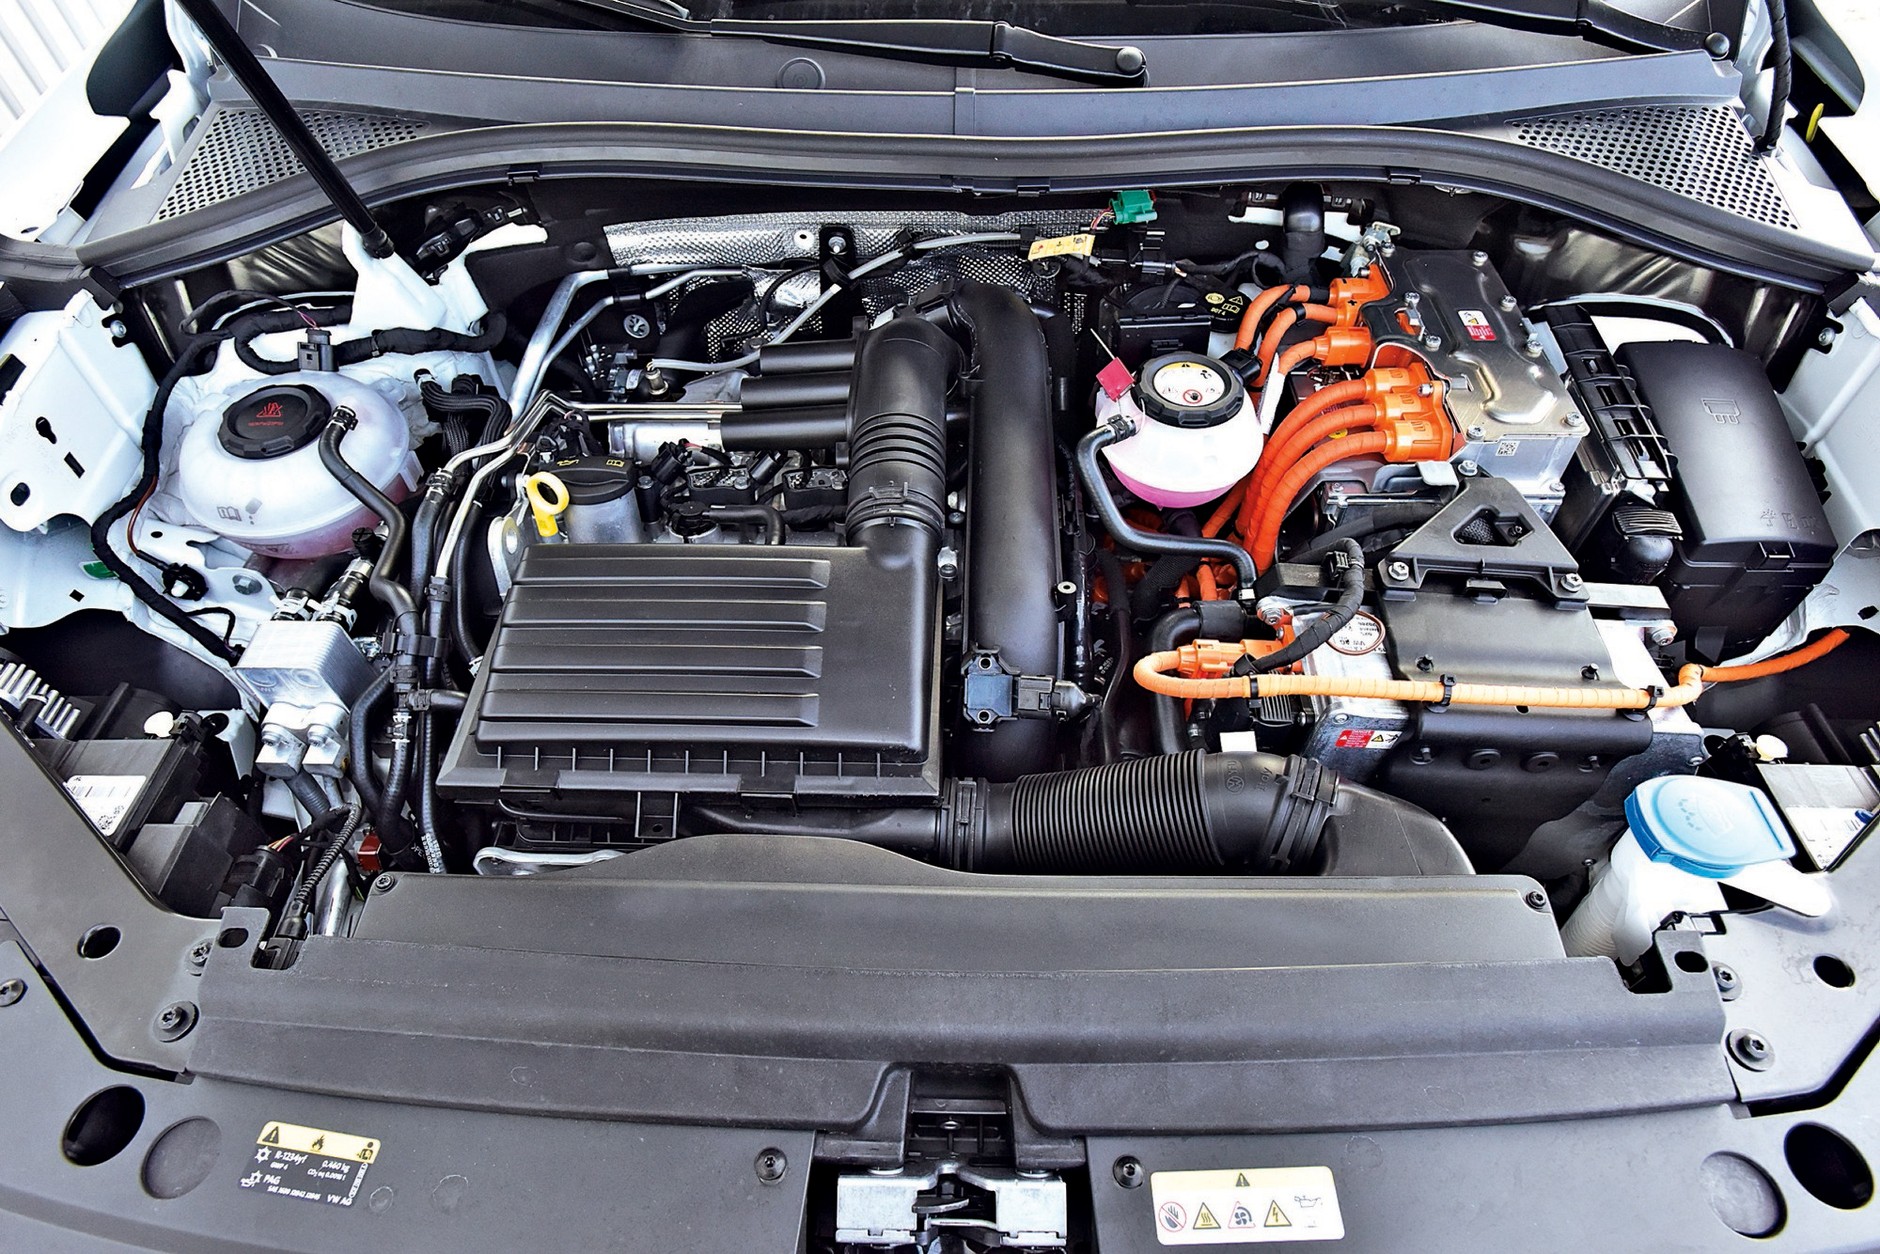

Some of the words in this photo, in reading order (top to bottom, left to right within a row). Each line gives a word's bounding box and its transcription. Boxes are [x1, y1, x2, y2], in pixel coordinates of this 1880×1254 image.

[274, 1150, 308, 1165] R-1234yf
[340, 1163, 351, 1173] kg
[262, 1174, 281, 1185] PAG
[326, 1194, 342, 1205] VW
